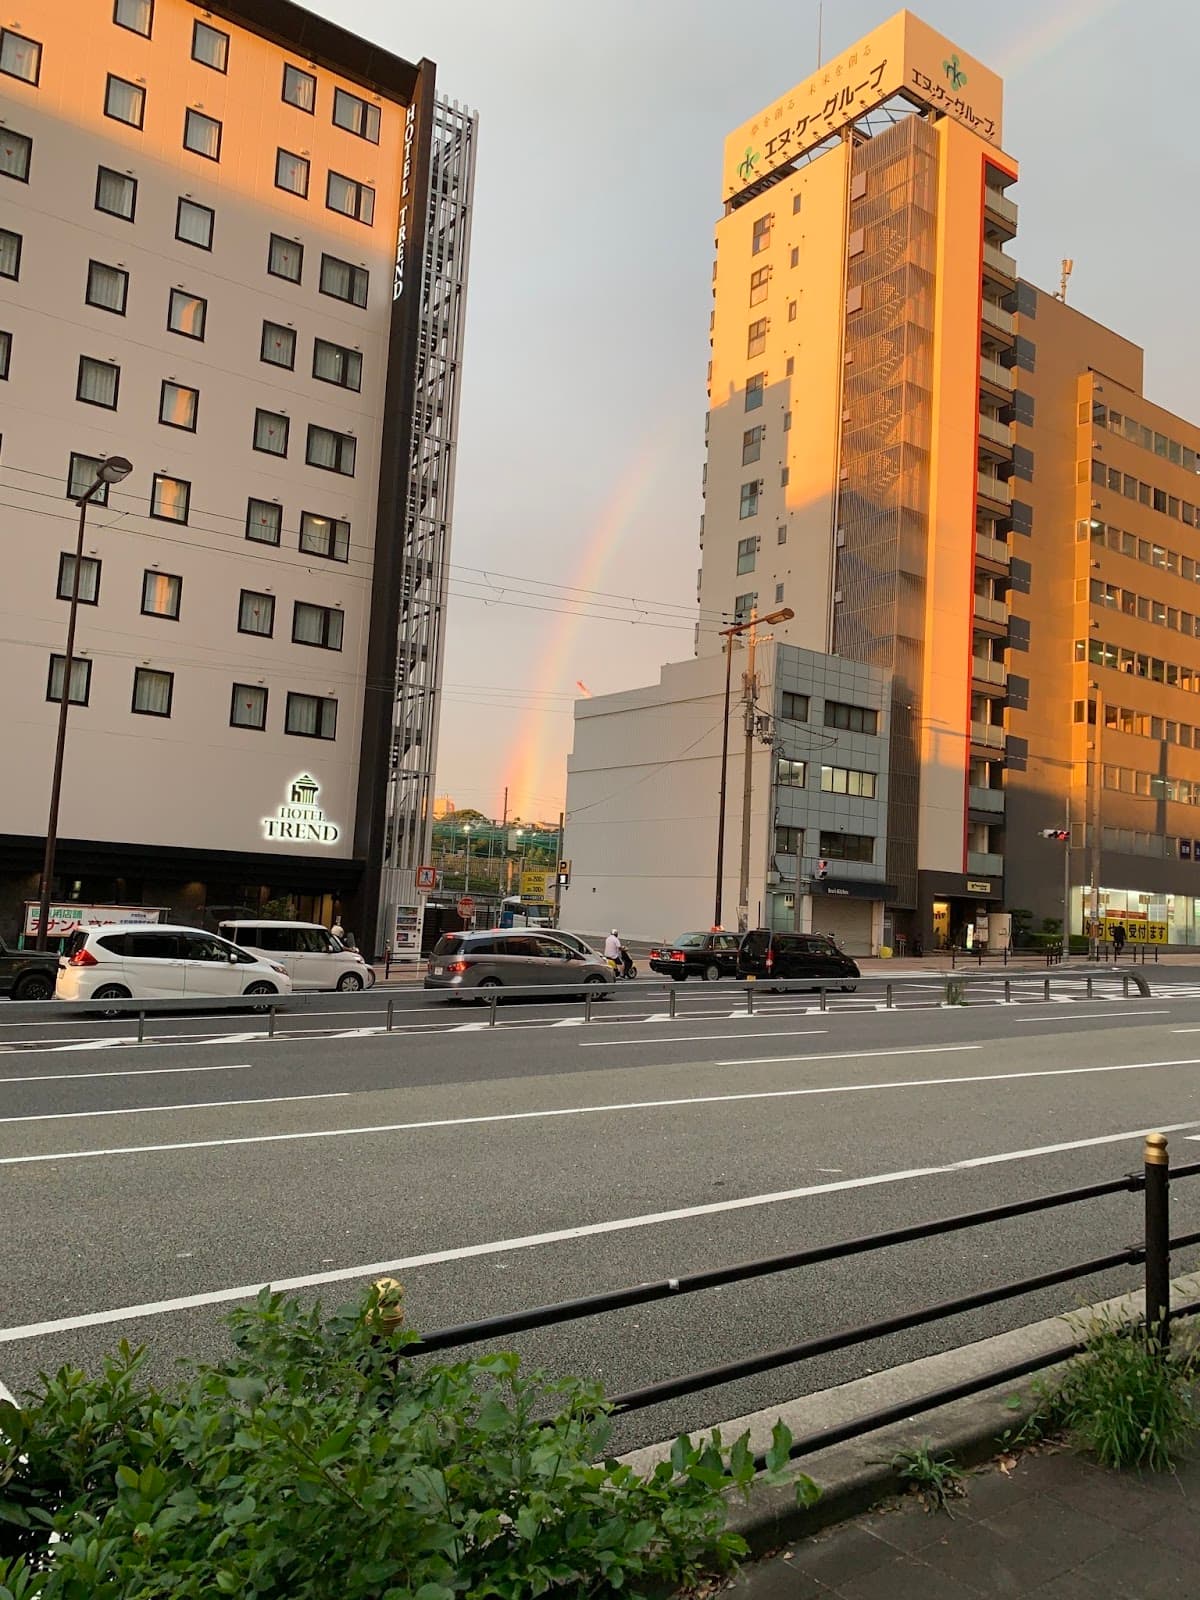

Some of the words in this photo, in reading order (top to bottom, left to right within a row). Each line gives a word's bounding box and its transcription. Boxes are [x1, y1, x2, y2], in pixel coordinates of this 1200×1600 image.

[401, 103, 417, 198] HOTEL
[393, 205, 408, 301] TREND
[280, 807, 326, 822] HOTEL
[264, 820, 338, 841] TREND
[1085, 920, 1166, 940] 方せ受付ます
